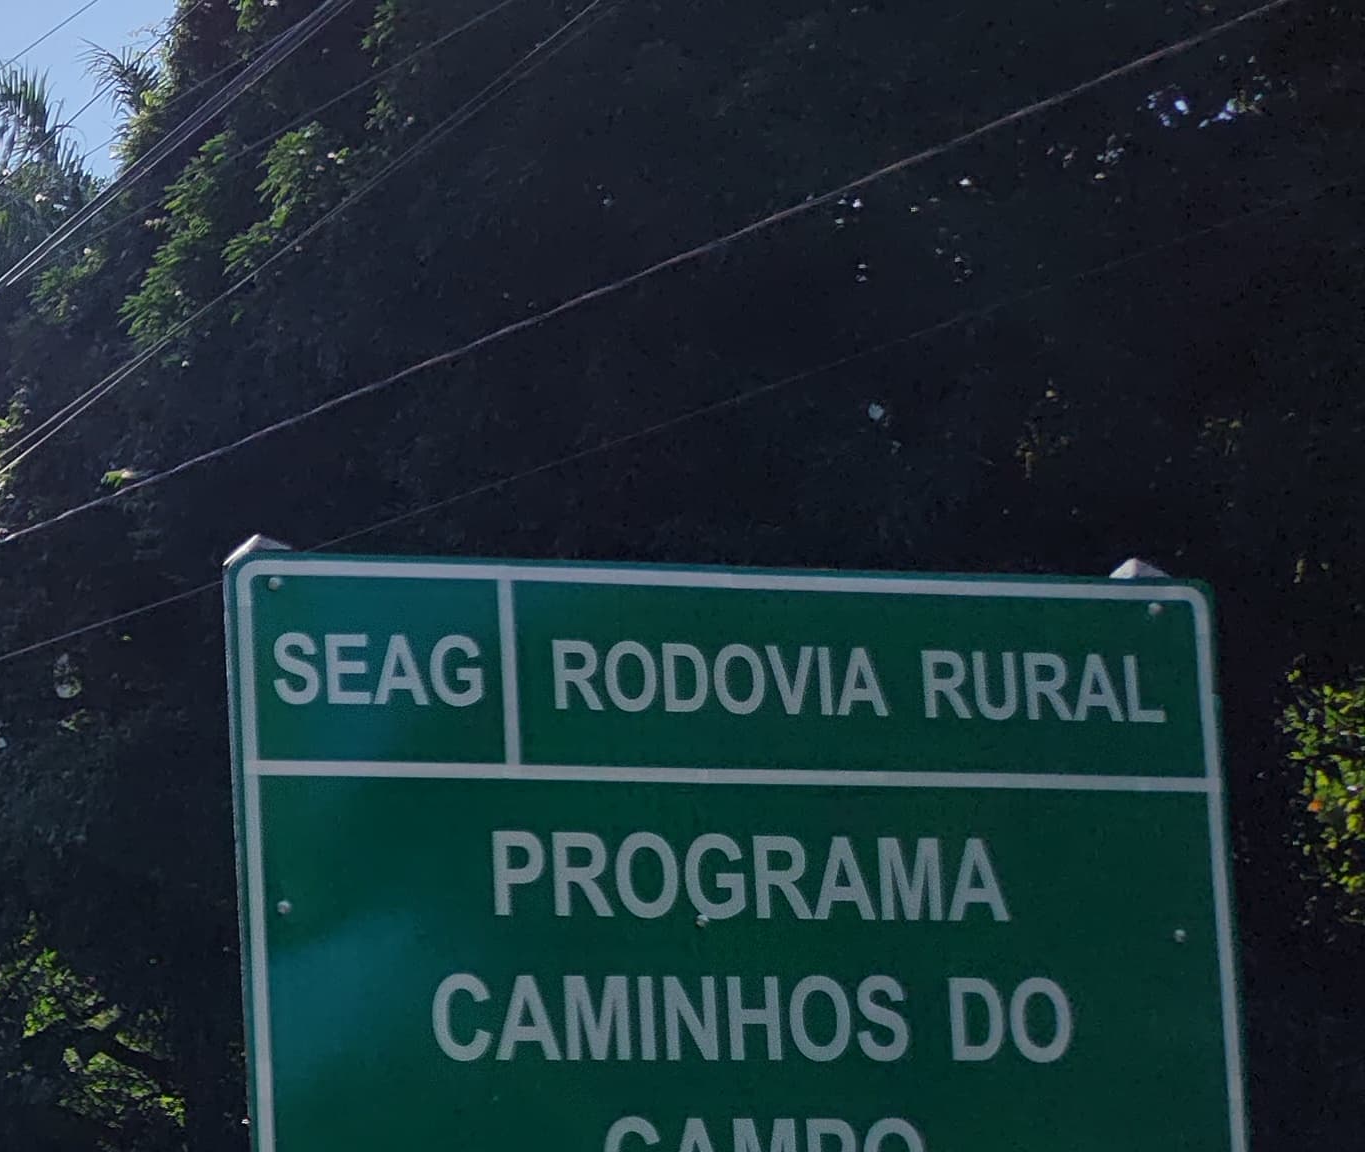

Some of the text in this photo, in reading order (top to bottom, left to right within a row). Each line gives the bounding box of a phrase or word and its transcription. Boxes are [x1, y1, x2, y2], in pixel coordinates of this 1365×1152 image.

[272, 632, 484, 707] SEAG
[551, 639, 1167, 724] RODOVIA RURAL
[491, 830, 1011, 924] PROGRAMA
[432, 972, 1073, 1064] CAMINHOS DO
